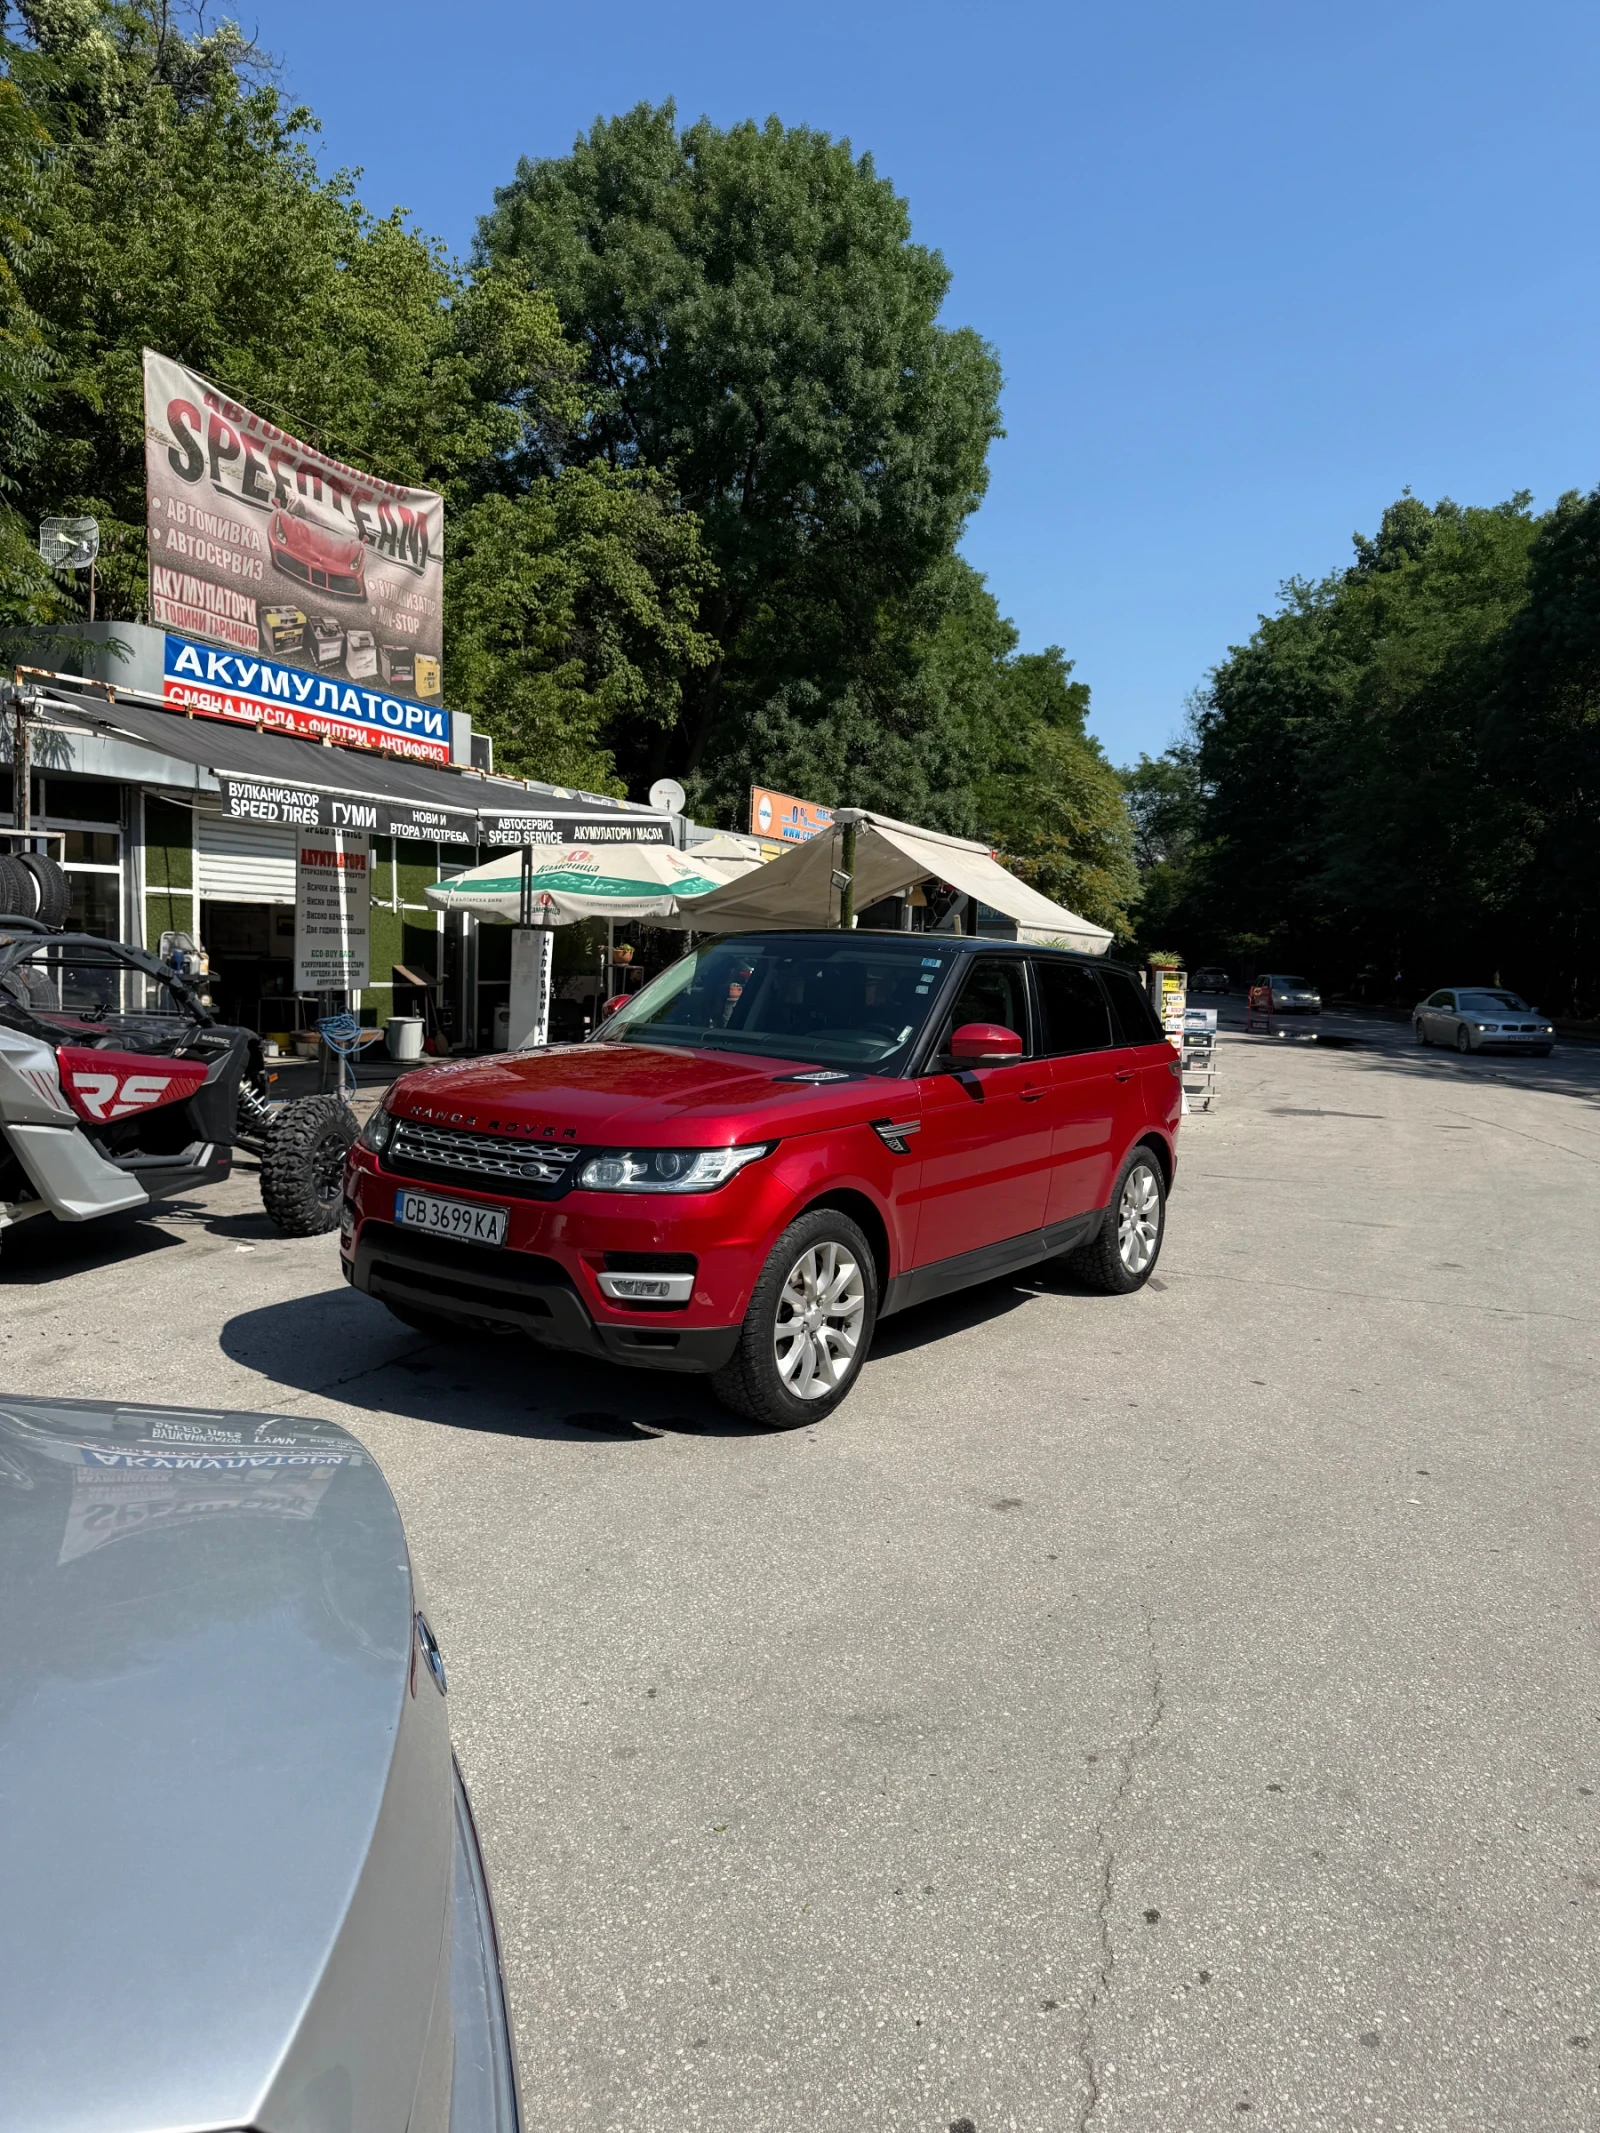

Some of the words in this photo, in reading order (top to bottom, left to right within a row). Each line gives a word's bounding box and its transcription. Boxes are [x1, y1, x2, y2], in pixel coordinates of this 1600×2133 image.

[167, 497, 262, 551] АВТОМИВКА
[166, 527, 264, 580] АВТОСЕРВИЗ
[153, 564, 257, 626] АКУМУЛАТОРИ
[164, 601, 207, 632] ГОДИНИ
[209, 615, 258, 647] ГАРАНЦИЯ
[379, 605, 420, 635] NON-STOP
[174, 645, 444, 736] АКУМУЛАТОРИ
[169, 687, 235, 713] СМЯНА
[240, 702, 296, 730] МАСЛА
[308, 718, 368, 744] ФИЛТРИ
[379, 734, 445, 762] АНТИФРИЗ
[228, 782, 320, 808] ВУЛКАНИЗАТОР
[230, 798, 279, 820] SPEED
[281, 804, 320, 826] TIRES
[331, 802, 377, 828] ГУМИ
[412, 810, 438, 825] НОВИ
[440, 814, 447, 826] И
[498, 818, 554, 831] АВТОСЕРВИЗ
[389, 823, 421, 838] ВТОРА
[422, 827, 470, 843] УПОТРЕБА
[488, 830, 522, 844] SPEED
[523, 831, 563, 844] SERVICE
[574, 826, 632, 840] АКУМУЛАТОРИ
[636, 827, 664, 840] МАСЛА
[536, 862, 600, 873] Каменица
[540, 937, 550, 1010] НАЛИВНИ
[410, 1105, 479, 1126] RANGE
[488, 1120, 577, 1138] ROVER
